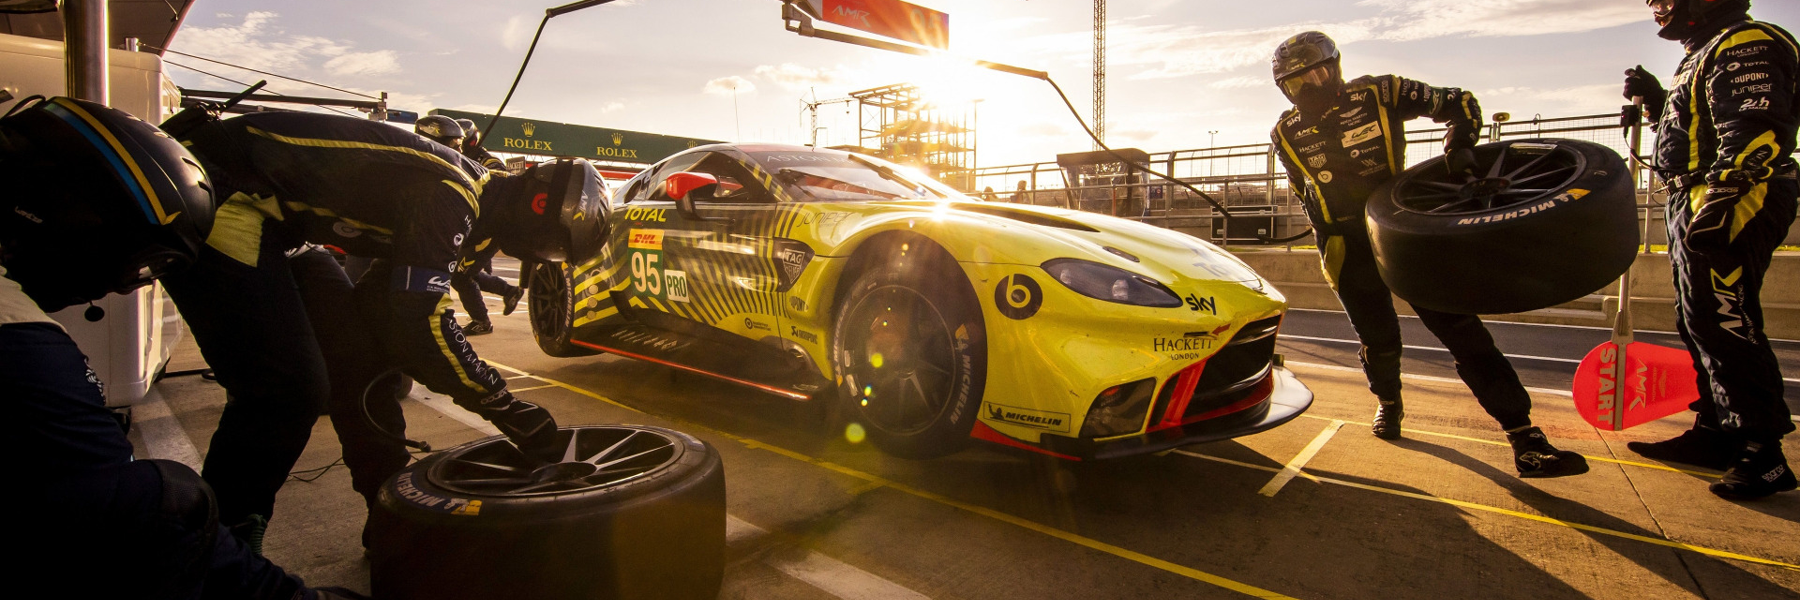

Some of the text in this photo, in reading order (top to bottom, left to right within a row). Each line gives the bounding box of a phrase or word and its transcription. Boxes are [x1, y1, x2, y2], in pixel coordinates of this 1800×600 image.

[1727, 45, 1769, 56] HACKETT
[1734, 72, 1766, 83] DUPONT
[504, 137, 552, 151] ROLEX
[1299, 141, 1326, 153] HACKETT
[596, 146, 637, 159] ROLEX
[625, 207, 667, 222] TOTAL
[1457, 200, 1556, 225] MICHELIN
[634, 233, 656, 244] DHL
[785, 251, 803, 264] TAG
[631, 251, 661, 296] 95
[666, 274, 687, 298] PRO
[1185, 294, 1217, 316] sky
[1153, 338, 1214, 352] HACKETT
[1170, 352, 1200, 361] LONDON
[950, 354, 971, 425] MICHELIN
[1598, 348, 1616, 425] START
[1005, 412, 1063, 426] MICHELIN
